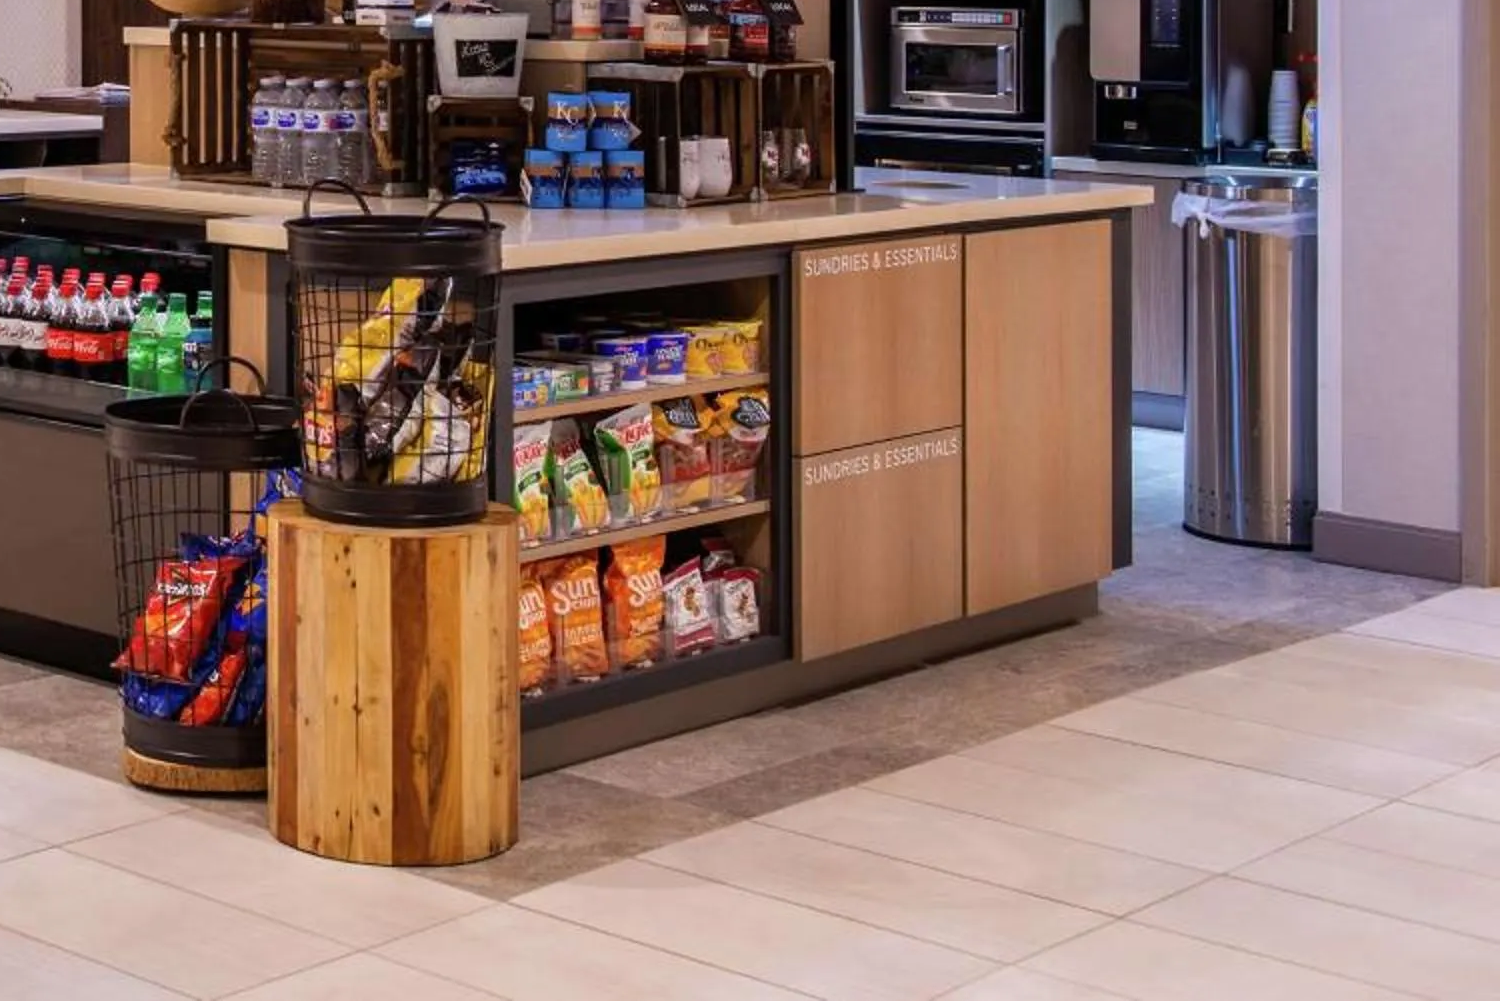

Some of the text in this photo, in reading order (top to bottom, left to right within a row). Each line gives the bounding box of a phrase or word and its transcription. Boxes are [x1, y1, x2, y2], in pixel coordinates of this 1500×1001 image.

[804, 252, 869, 277] SUNDRIES
[885, 243, 958, 268] ESSENTIALS
[804, 454, 869, 486] SUNDRIES
[885, 437, 958, 468] ESSENTIALS
[550, 576, 599, 615] Sun
